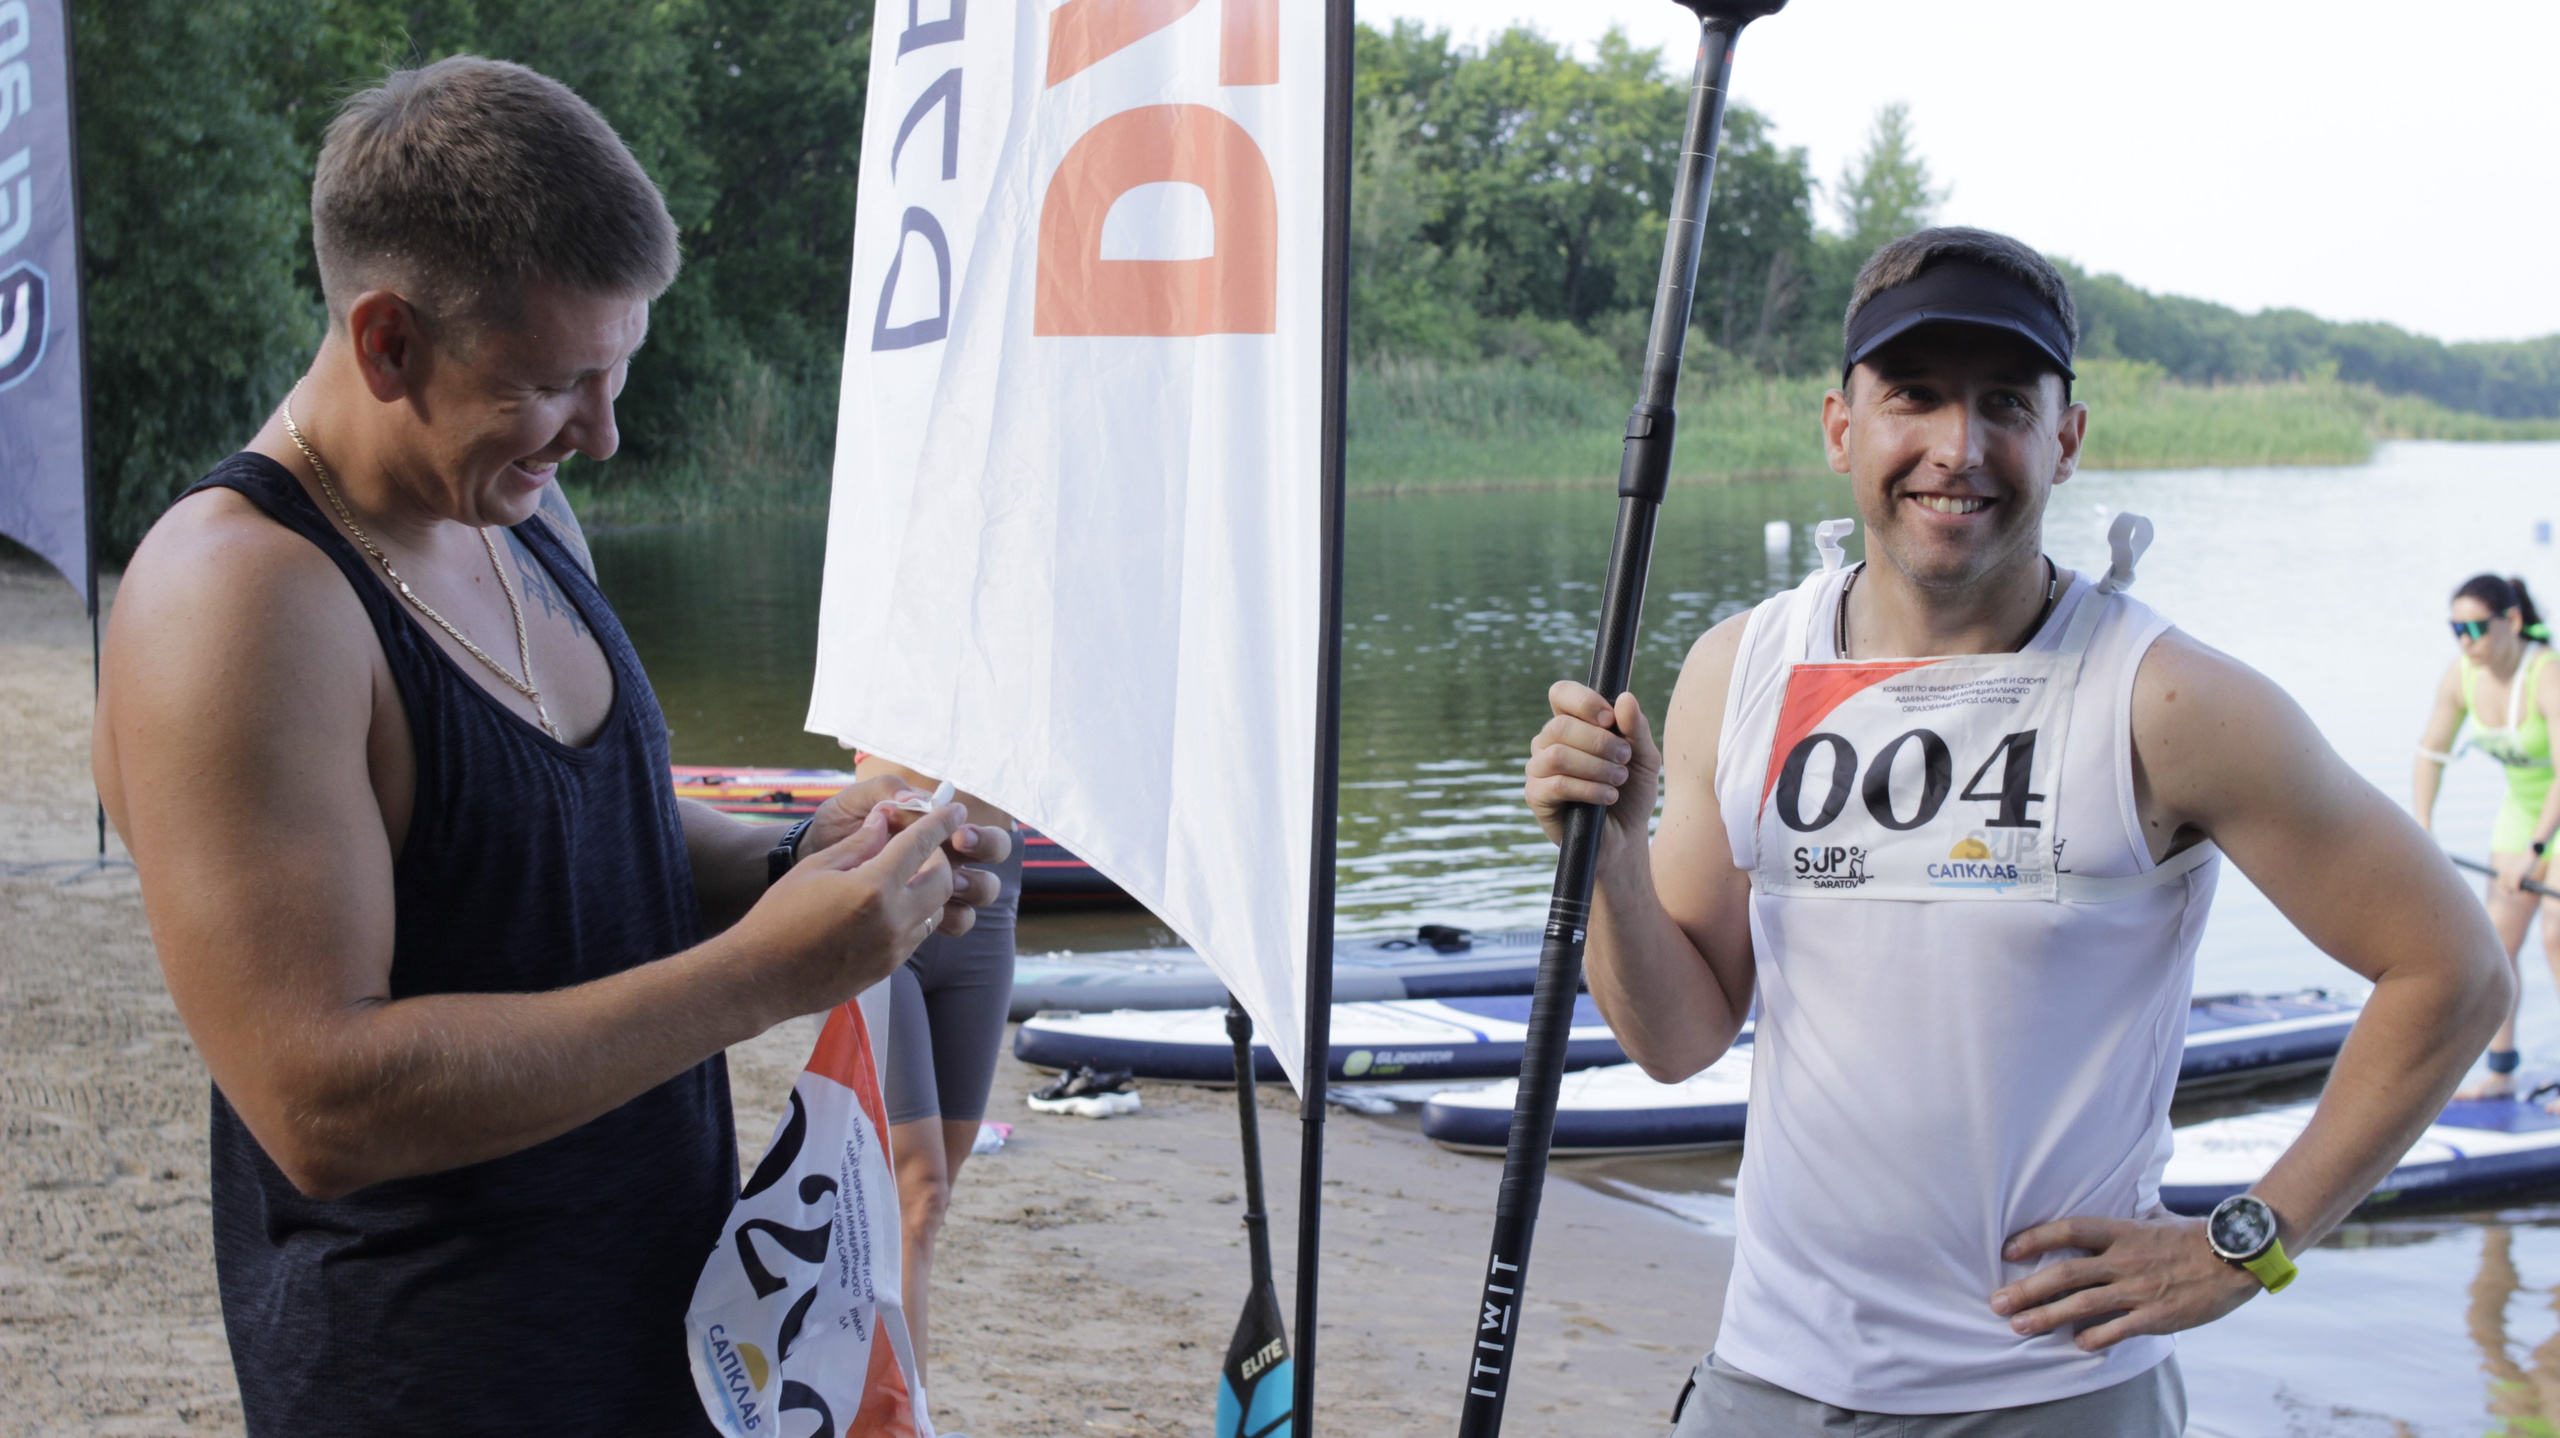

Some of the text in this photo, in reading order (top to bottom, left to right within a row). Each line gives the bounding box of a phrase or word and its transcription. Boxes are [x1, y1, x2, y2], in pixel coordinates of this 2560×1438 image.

[1882, 685, 1914, 693] КОМИТЕТ
[1915, 685, 1928, 693] ПО
[1975, 677, 2009, 687] КУЛЬТУРЕ
[2017, 677, 2047, 685] СПОРТУ
[1776, 728, 2047, 833] 004
[1794, 846, 1847, 874] SUP
[1927, 863, 2018, 879] САПКЛАБ
[1814, 880, 1859, 889] SARATOV
[1471, 1254, 1518, 1398] ITIWIT
[1241, 1337, 1284, 1381] ELITE
[709, 1324, 761, 1431] САПКЛАБ
